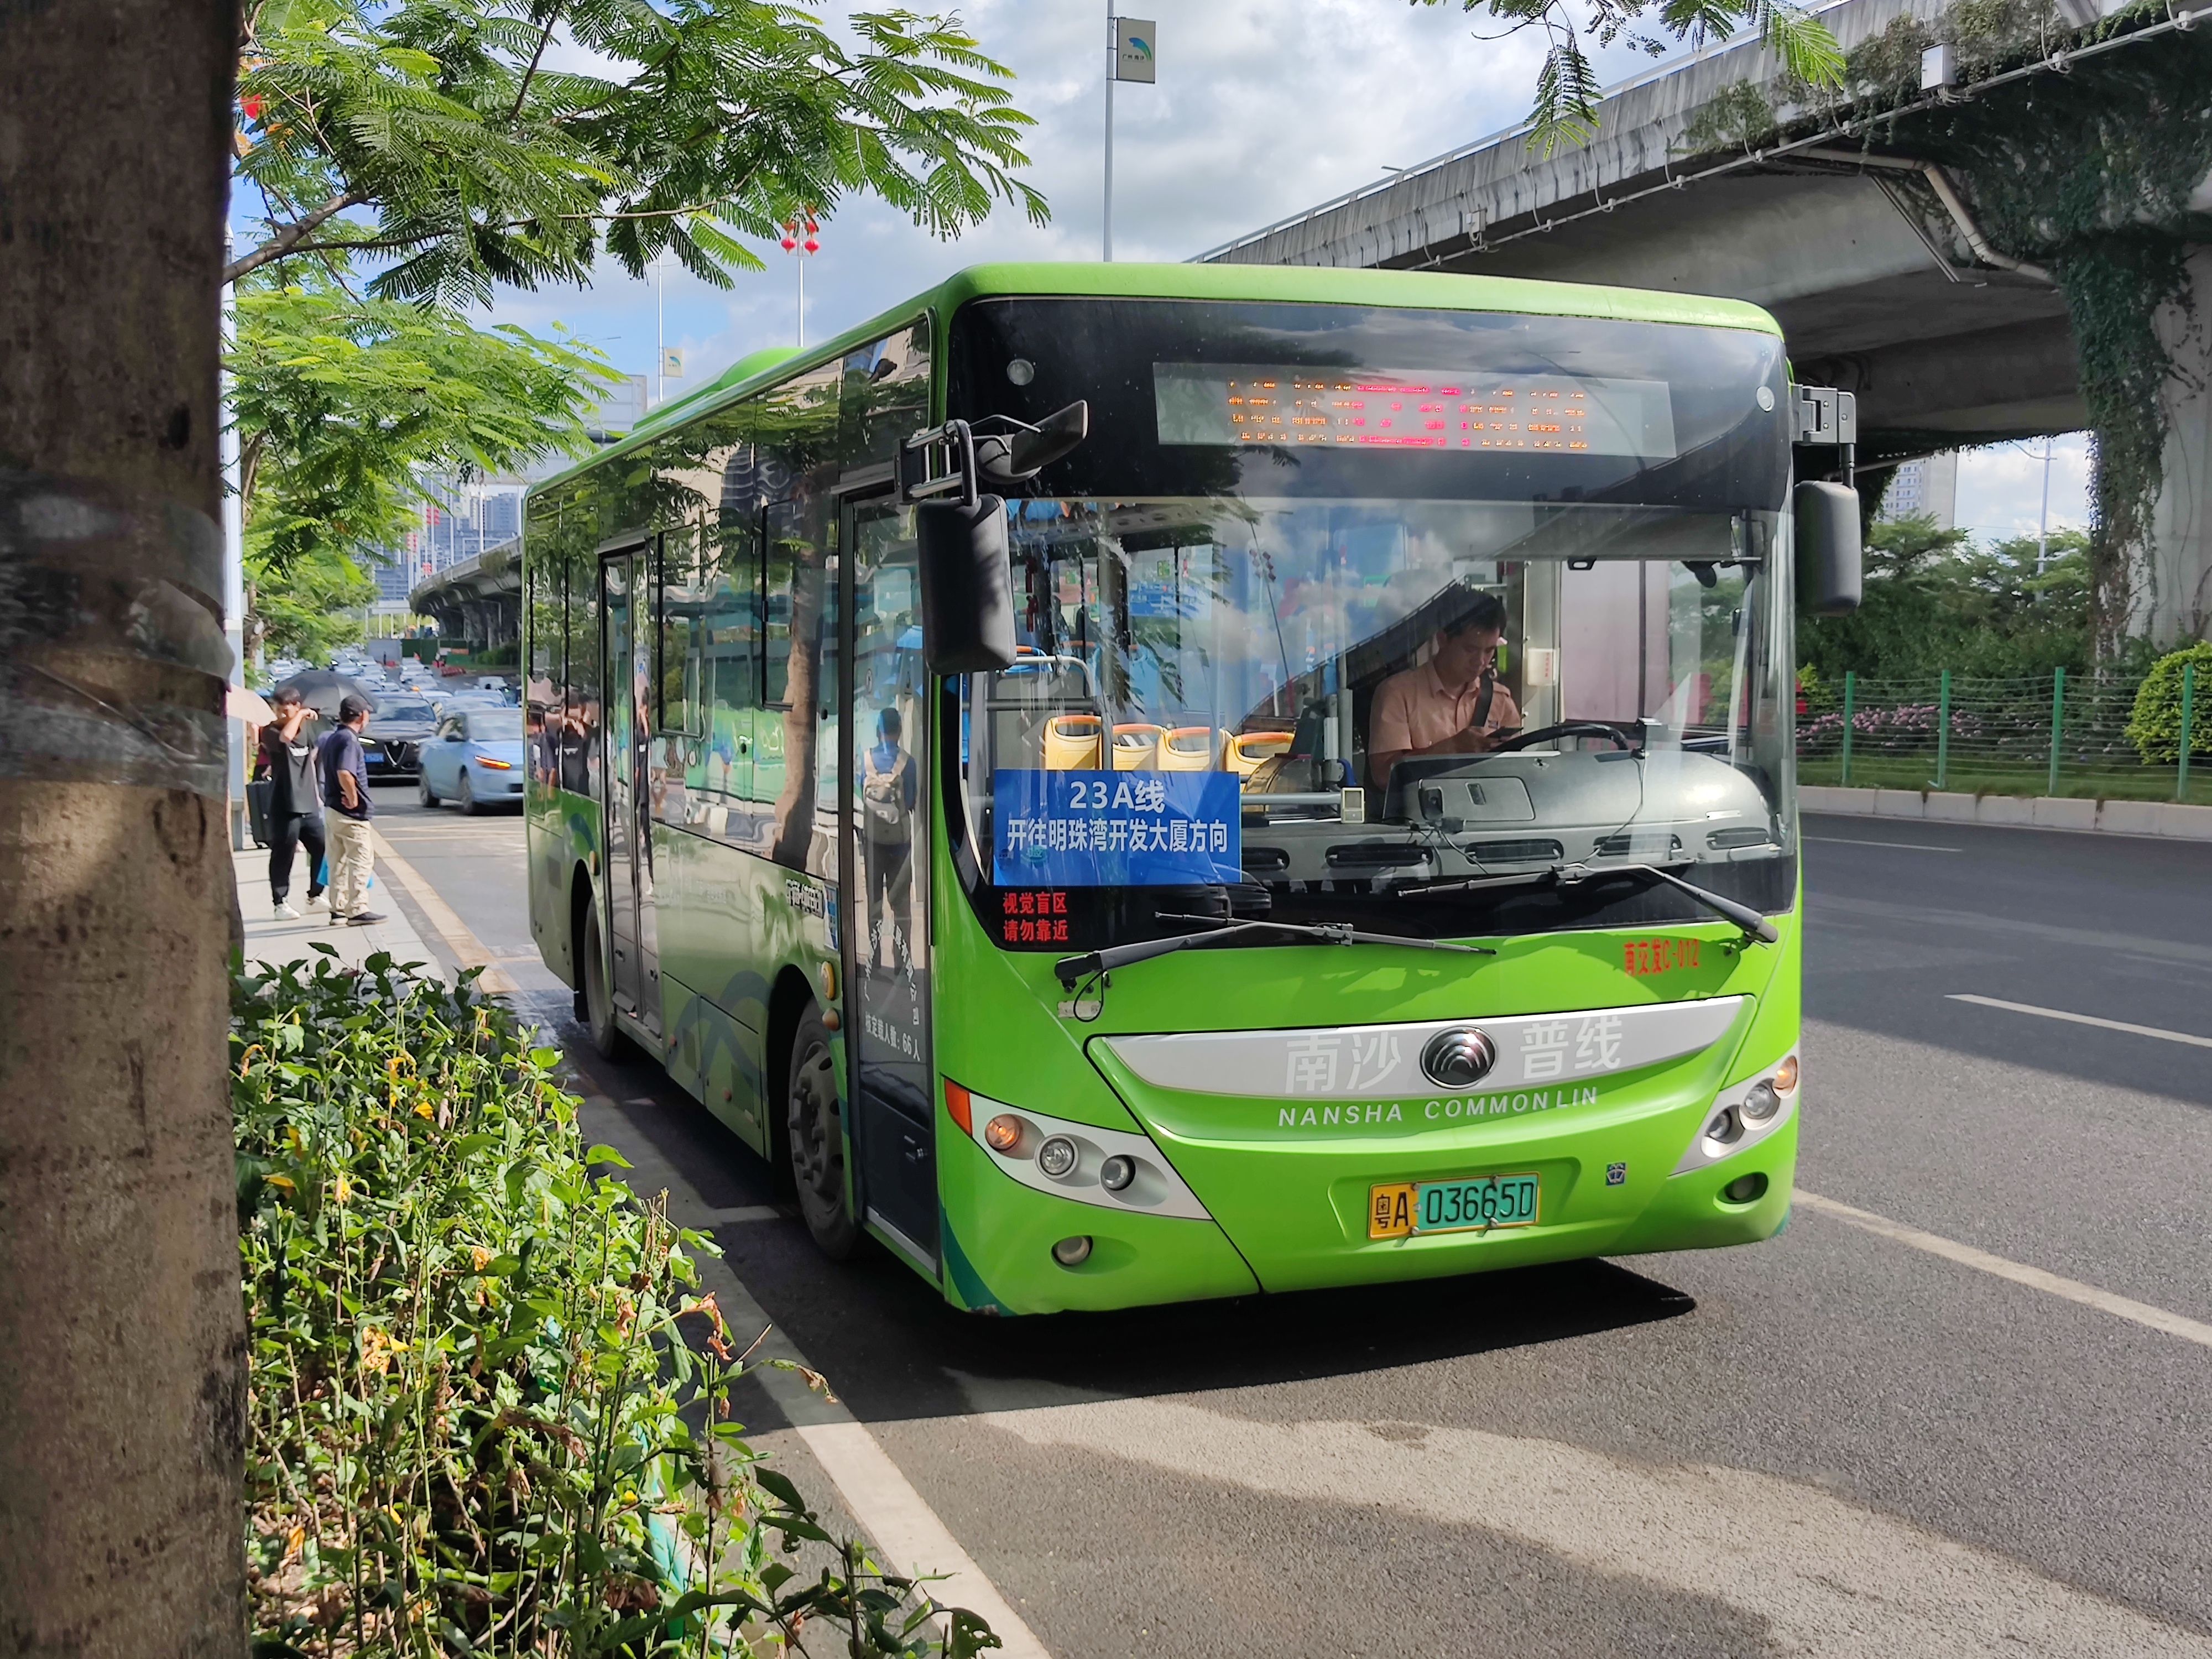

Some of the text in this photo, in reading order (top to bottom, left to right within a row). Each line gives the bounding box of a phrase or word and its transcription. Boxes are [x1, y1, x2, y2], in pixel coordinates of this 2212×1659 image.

[1070, 779, 1166, 813] 23A线
[1007, 817, 1228, 853] 开往明珠湾开发大厦方向
[1003, 891, 1067, 915] 视觉盲区
[1003, 919, 1068, 942] 请勿靠近
[1285, 1015, 1624, 1094] 南沙 普线
[1278, 1103, 1402, 1126] NANSHA
